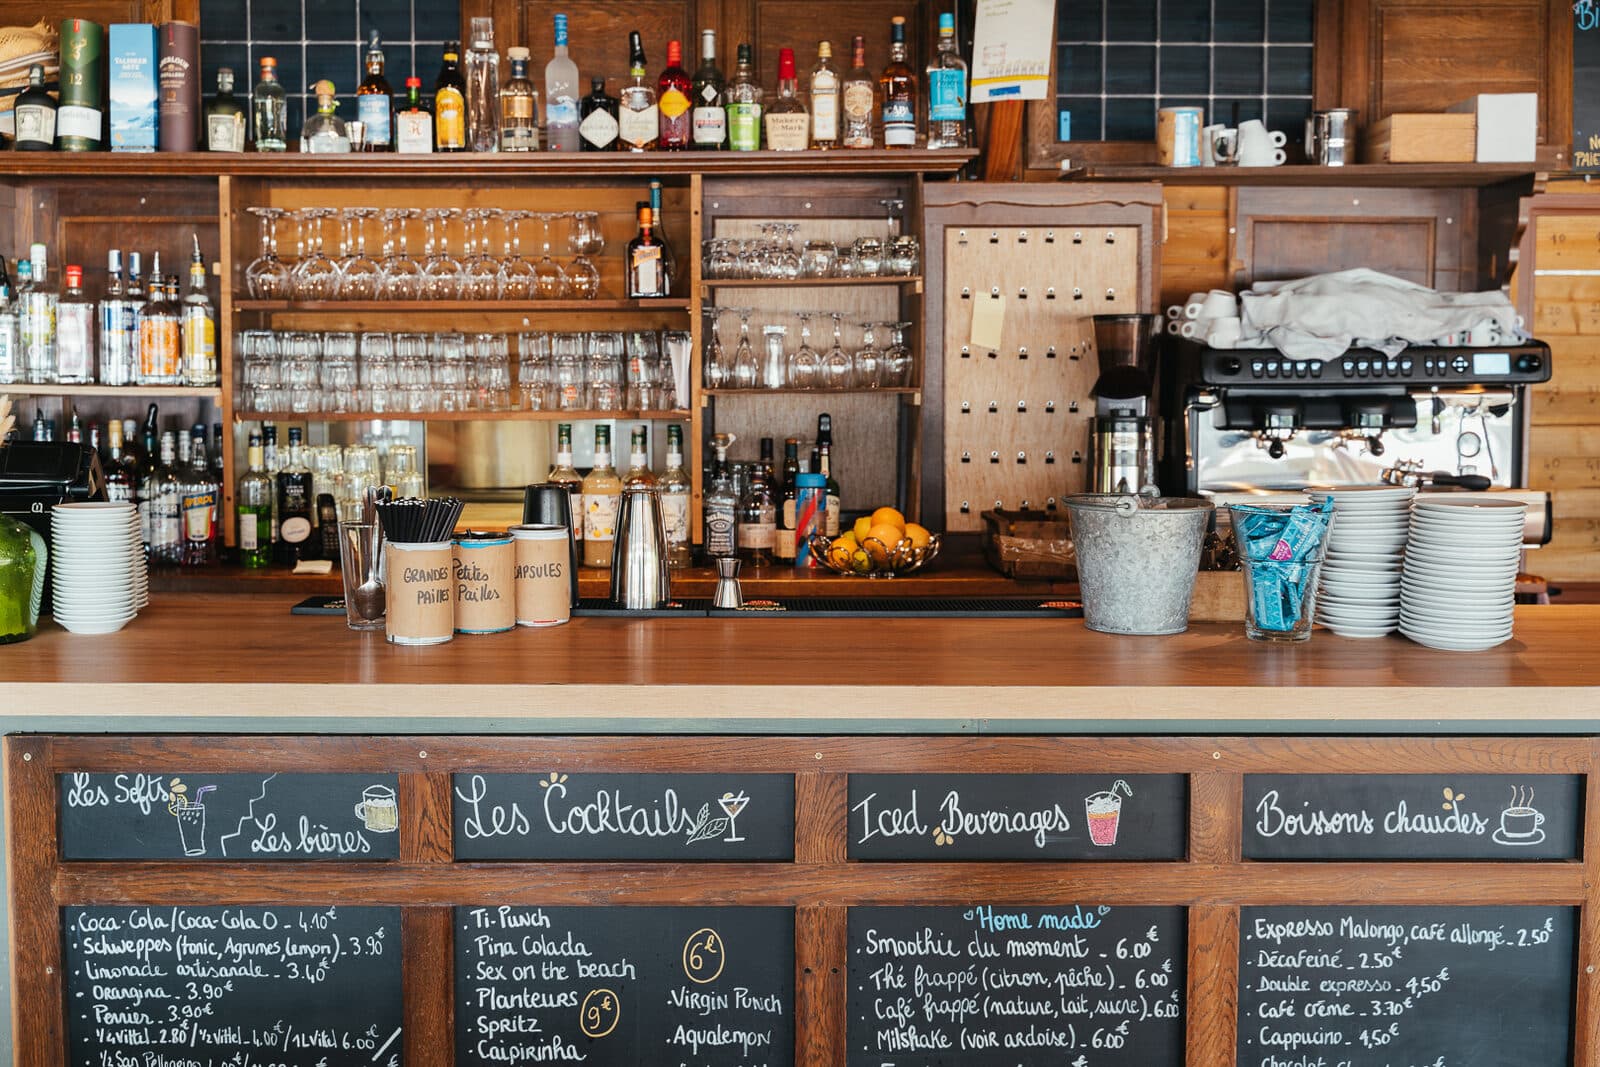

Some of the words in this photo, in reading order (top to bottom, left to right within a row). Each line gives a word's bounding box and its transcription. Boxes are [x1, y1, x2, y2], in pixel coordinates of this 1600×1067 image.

[403, 567, 449, 584] GRANDES
[67, 772, 109, 807] Les
[455, 774, 530, 838] Les
[543, 782, 697, 836] Cocktails
[851, 789, 928, 844] Iced
[940, 790, 1070, 848] Beverages
[1256, 790, 1374, 837] Boissons
[1384, 799, 1489, 835] chaudes
[250, 813, 292, 853] Les
[296, 815, 371, 854] bières
[976, 905, 1033, 933] Home
[1038, 904, 1102, 931] made
[1254, 917, 1334, 945] Expresso
[1410, 922, 1446, 941] café
[83, 934, 172, 961] Schweppes
[522, 931, 593, 957] Colada
[967, 930, 1001, 959] du
[1006, 934, 1090, 959] moment
[176, 959, 269, 978] artisanale
[476, 961, 507, 980] Sex
[512, 968, 536, 981] on
[541, 960, 569, 980] the
[576, 958, 636, 980] beach
[869, 961, 907, 991] Thé
[914, 963, 978, 998] frappé
[475, 986, 579, 1011] Planteurs
[1255, 974, 1311, 993] Double
[1319, 978, 1393, 997] expresso
[670, 985, 729, 1016] Virgin
[733, 987, 782, 1016] Punch
[874, 996, 916, 1029] Café
[922, 991, 981, 1025] frappé
[1258, 998, 1296, 1018] Café
[476, 1014, 543, 1040] Spritz
[960, 1027, 1000, 1051] (voir
[1259, 1026, 1343, 1052] Cappucino
[477, 1034, 588, 1066] Caipirinha
